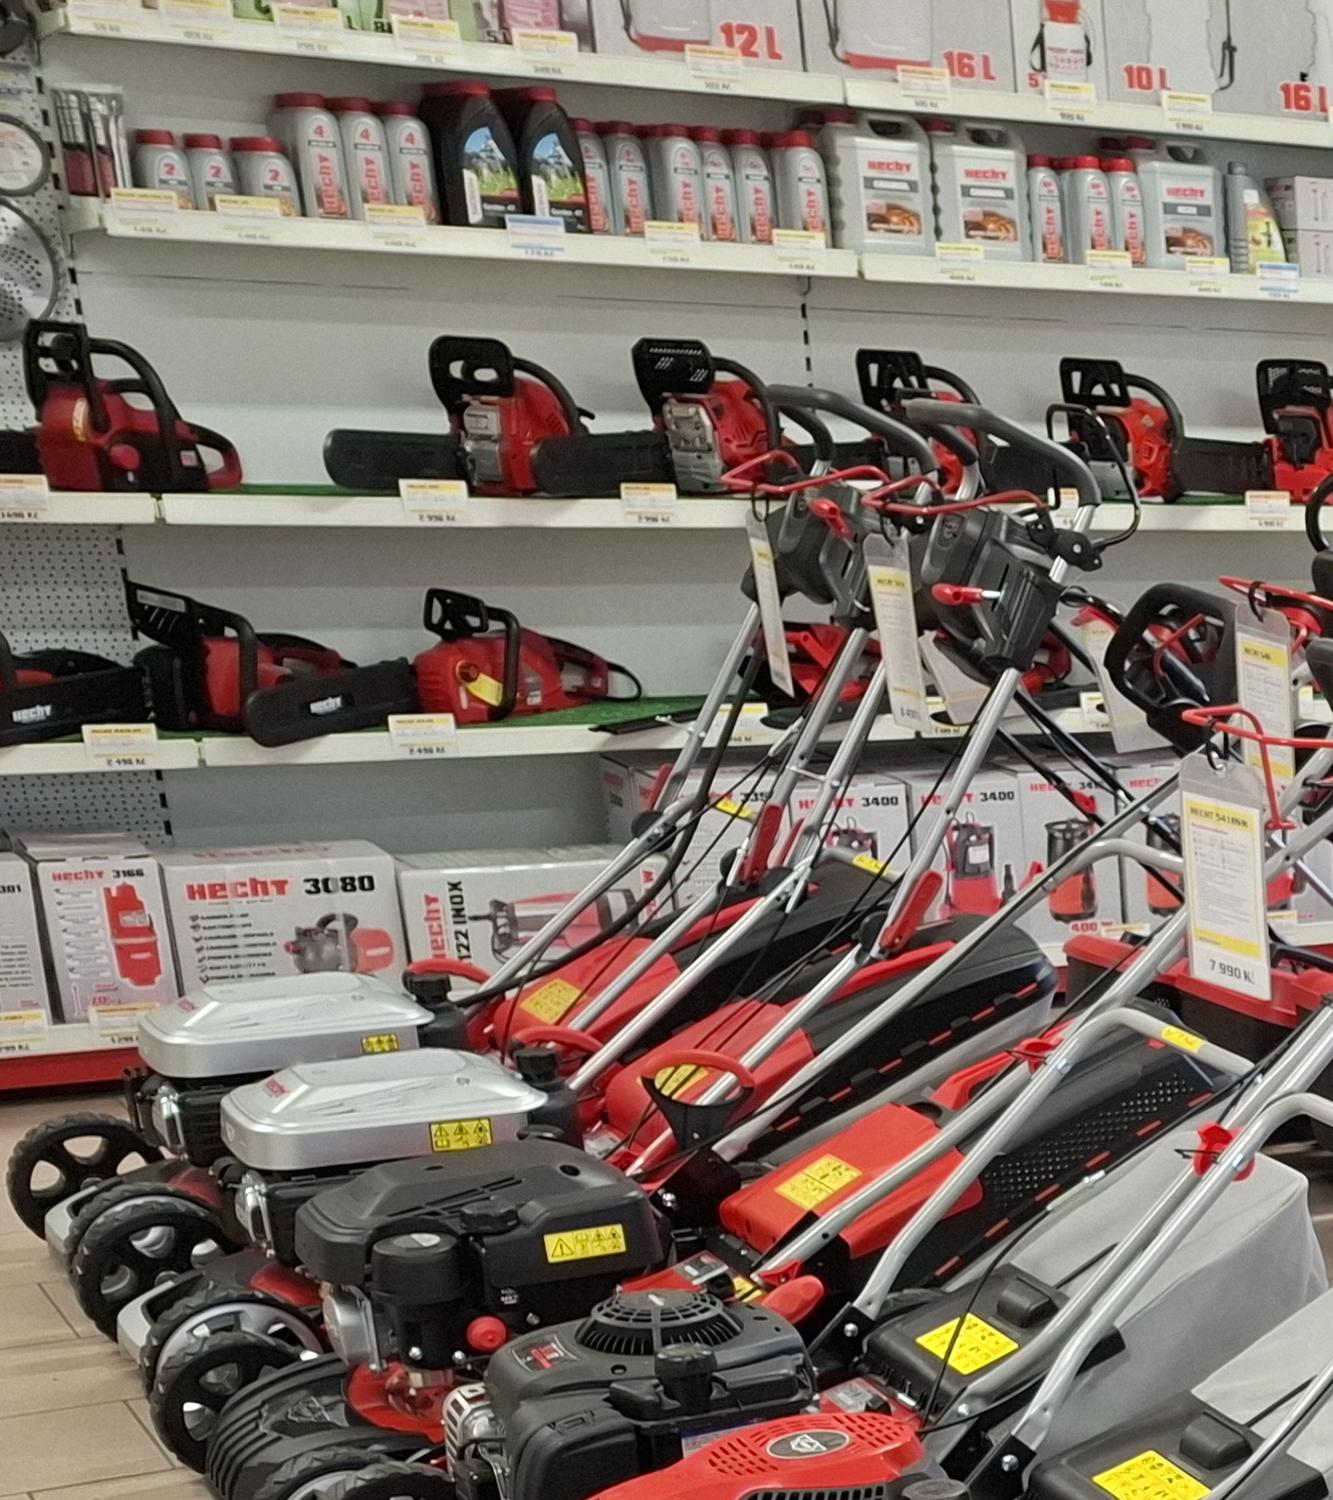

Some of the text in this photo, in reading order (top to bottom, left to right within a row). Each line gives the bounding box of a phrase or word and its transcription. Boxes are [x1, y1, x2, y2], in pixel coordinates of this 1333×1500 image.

[720, 22, 784, 60] 12 L
[944, 50, 997, 81] 16 L
[1122, 65, 1172, 92] 10 L
[1280, 81, 1330, 113] 16 L
[302, 874, 375, 895] 3080
[1219, 962, 1242, 981] 990
